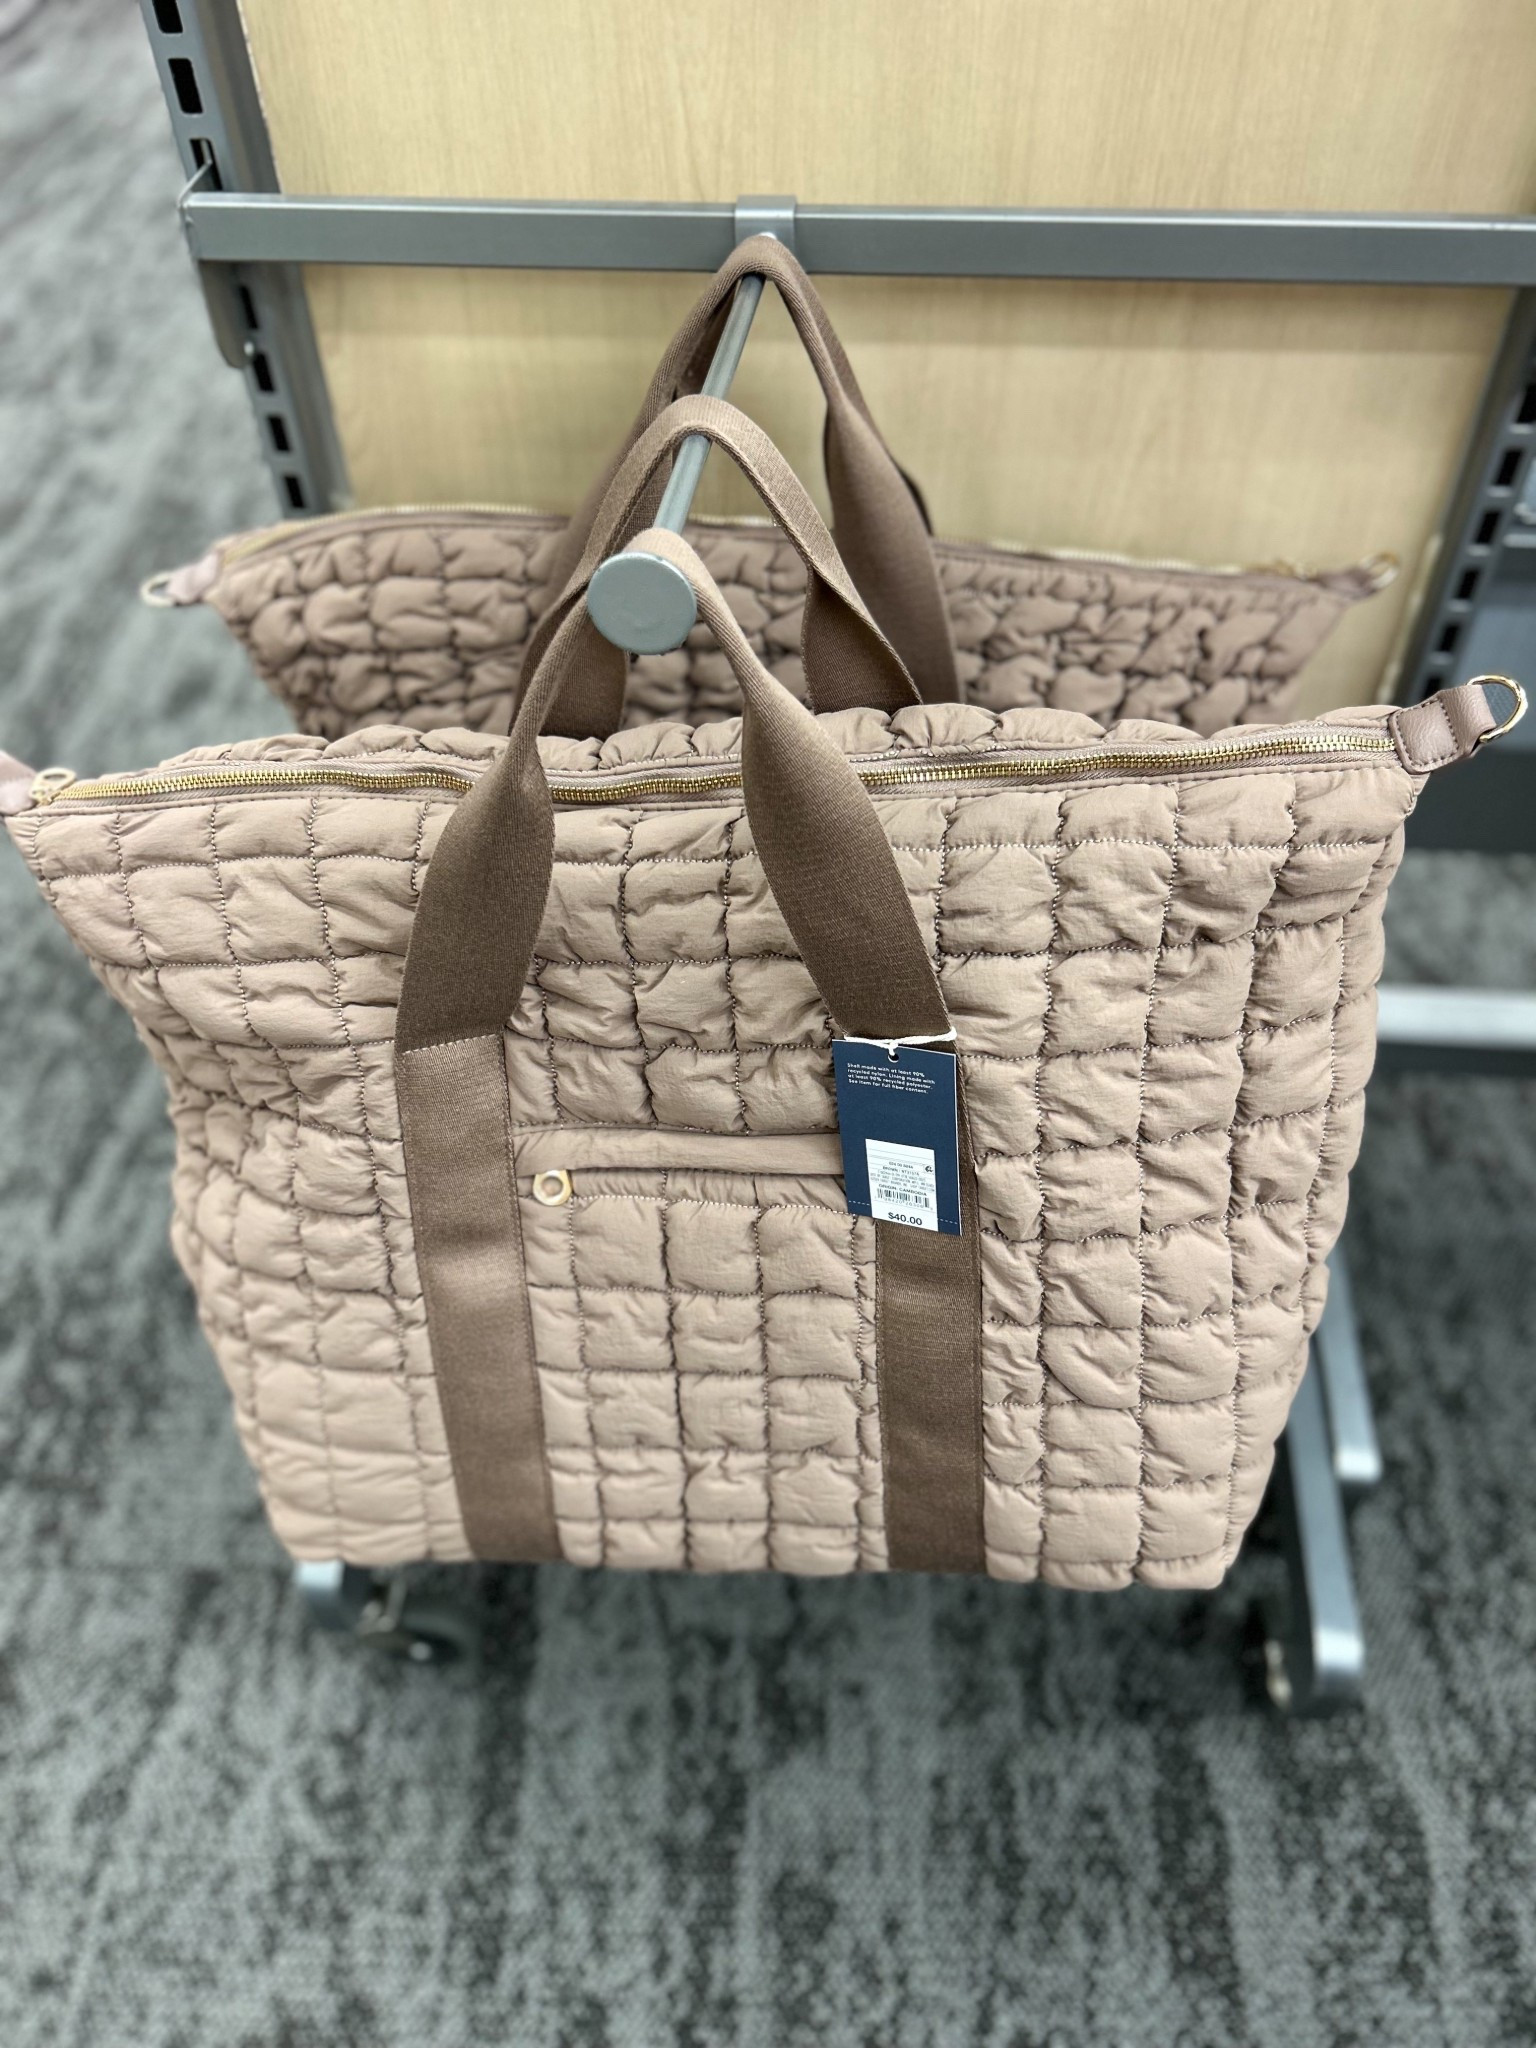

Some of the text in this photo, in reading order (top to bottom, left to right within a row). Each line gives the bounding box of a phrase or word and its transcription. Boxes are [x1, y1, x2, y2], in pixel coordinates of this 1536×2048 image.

[888, 1073, 905, 1081] Lining
[882, 1078, 905, 1086] recycled
[906, 1081, 933, 1090] polyester.
[899, 1188, 927, 1196] CAMBODIA
[888, 1212, 922, 1225] $40.00
